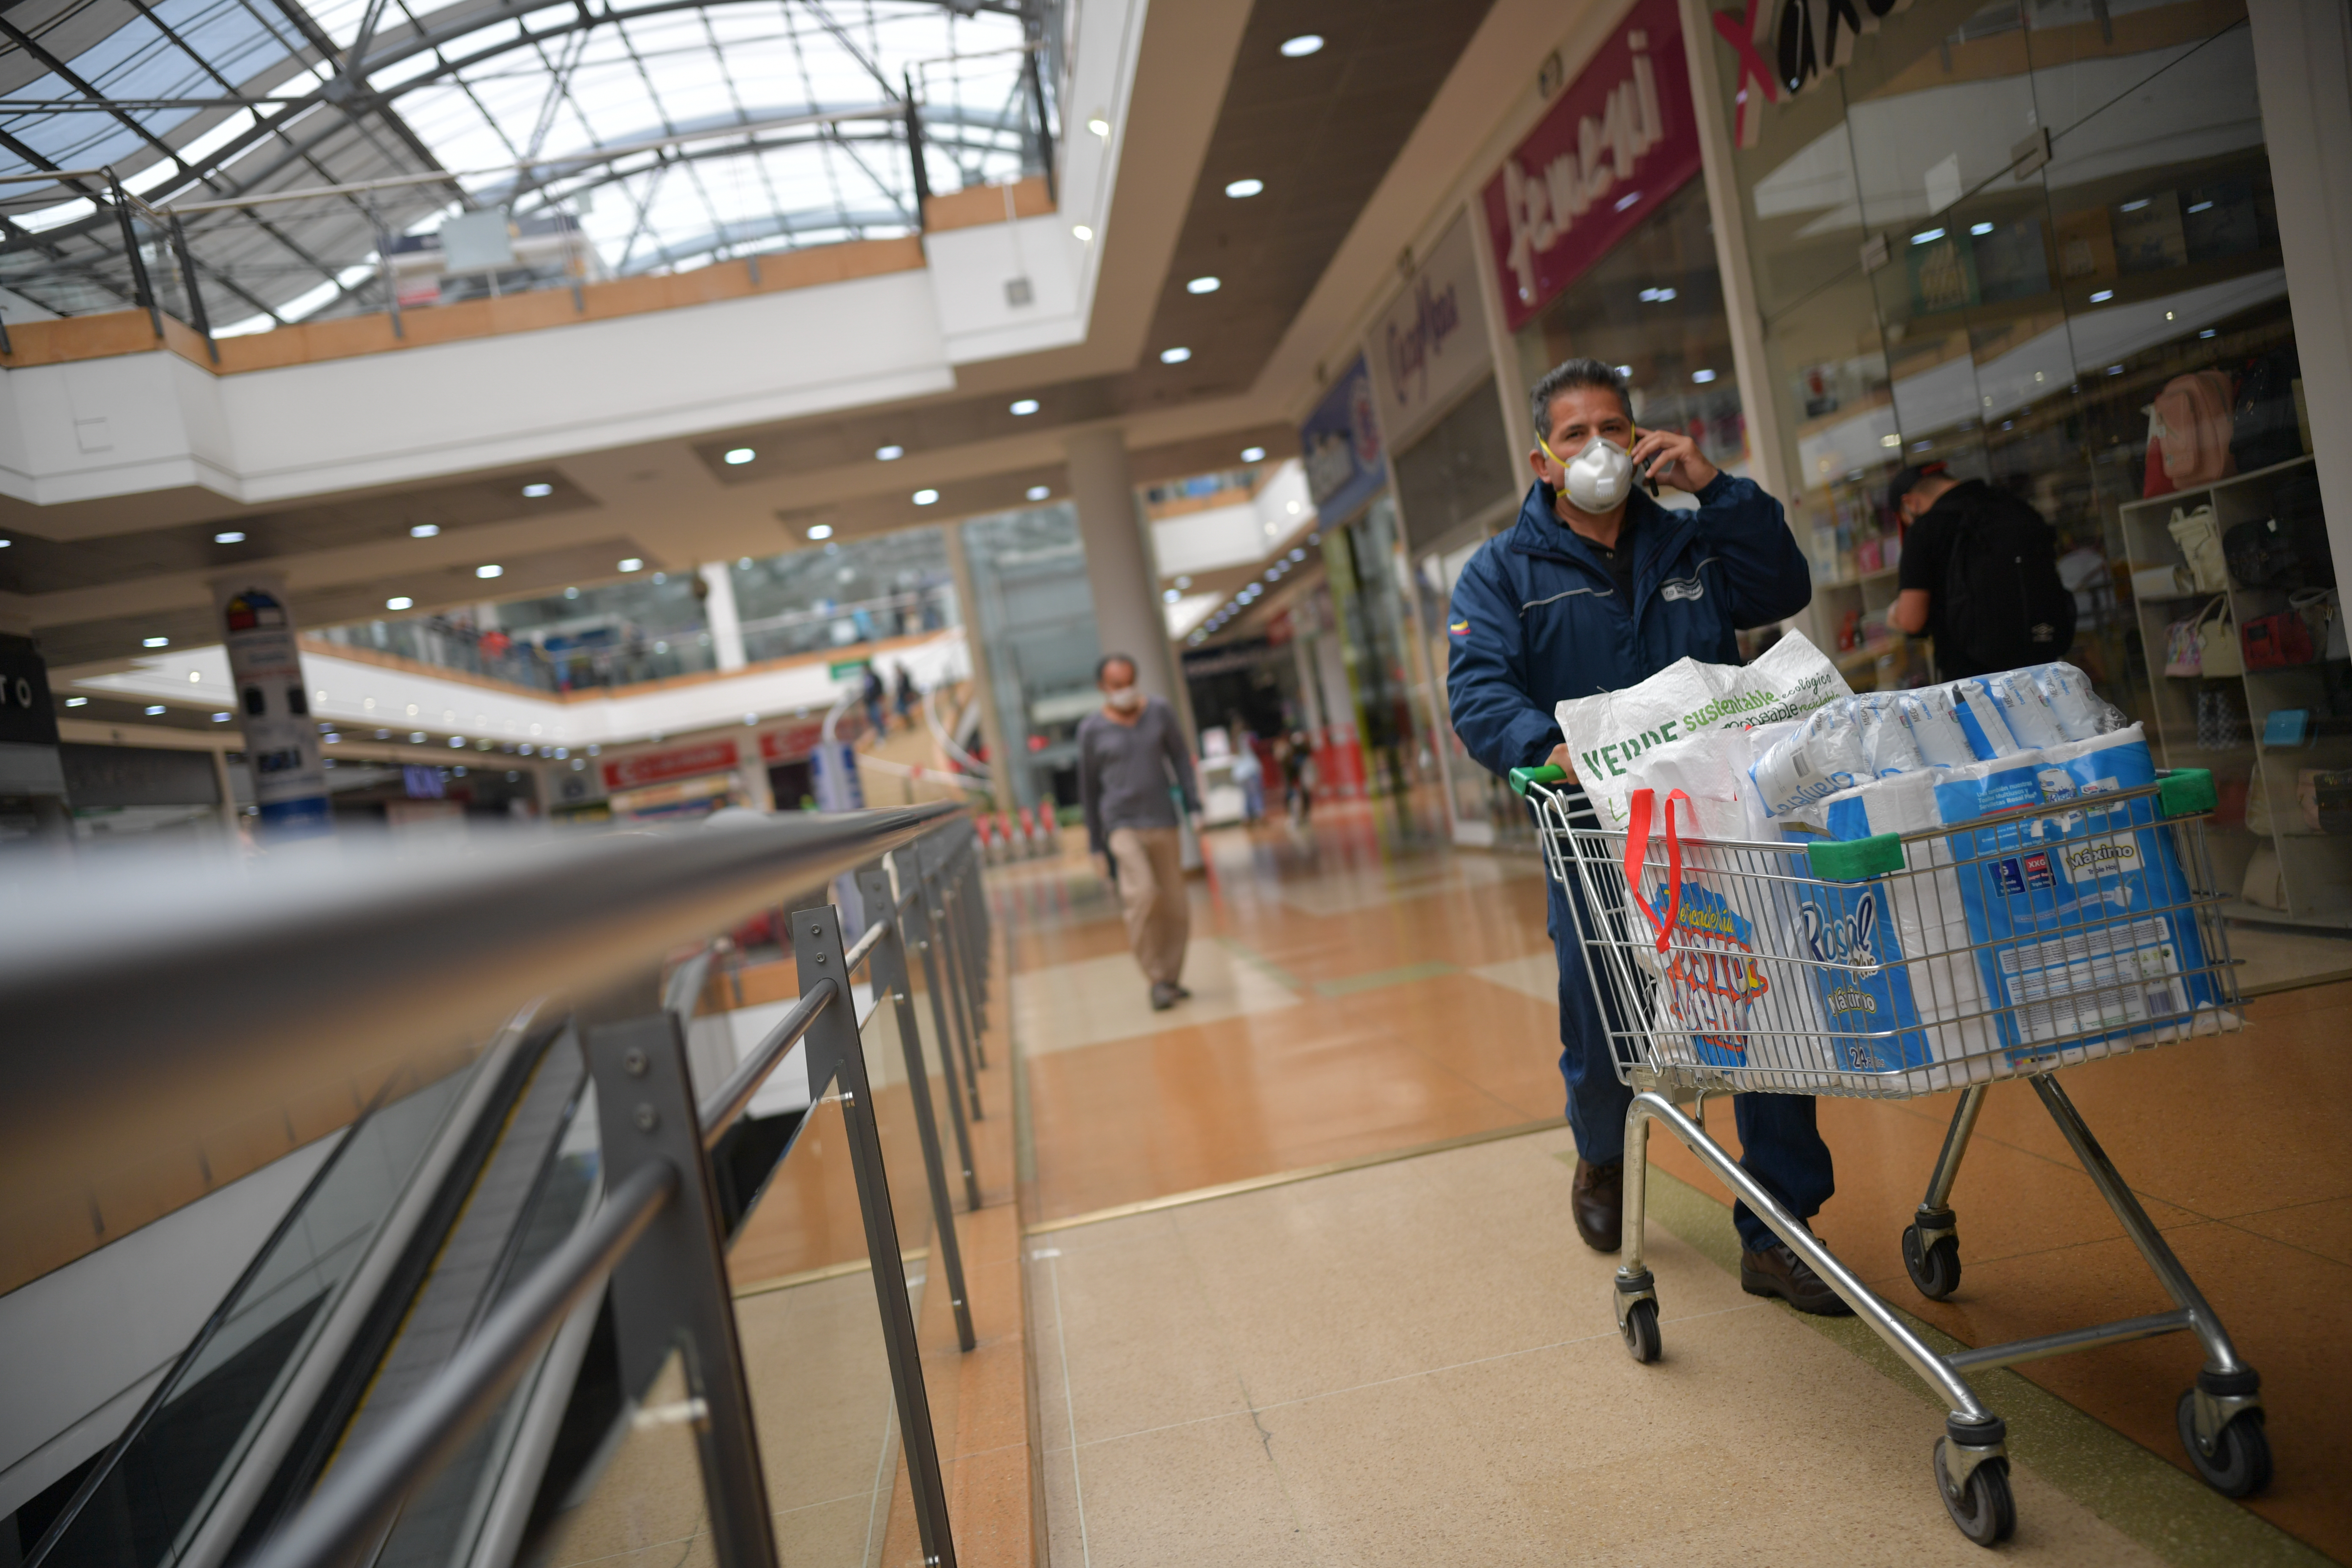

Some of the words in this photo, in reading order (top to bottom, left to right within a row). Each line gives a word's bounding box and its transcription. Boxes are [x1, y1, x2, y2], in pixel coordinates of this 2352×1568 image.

[1683, 690, 1780, 732] sustentable
[1782, 672, 1831, 699] ecológico
[2006, 795, 2024, 803] Rosal
[2028, 859, 2046, 868] XXG
[2066, 844, 2134, 870] Máximo
[1799, 892, 1876, 968] Rosal
[1849, 953, 1878, 984] Plus
[1827, 985, 1876, 1016] Máximo
[1849, 1046, 1867, 1069] 24
